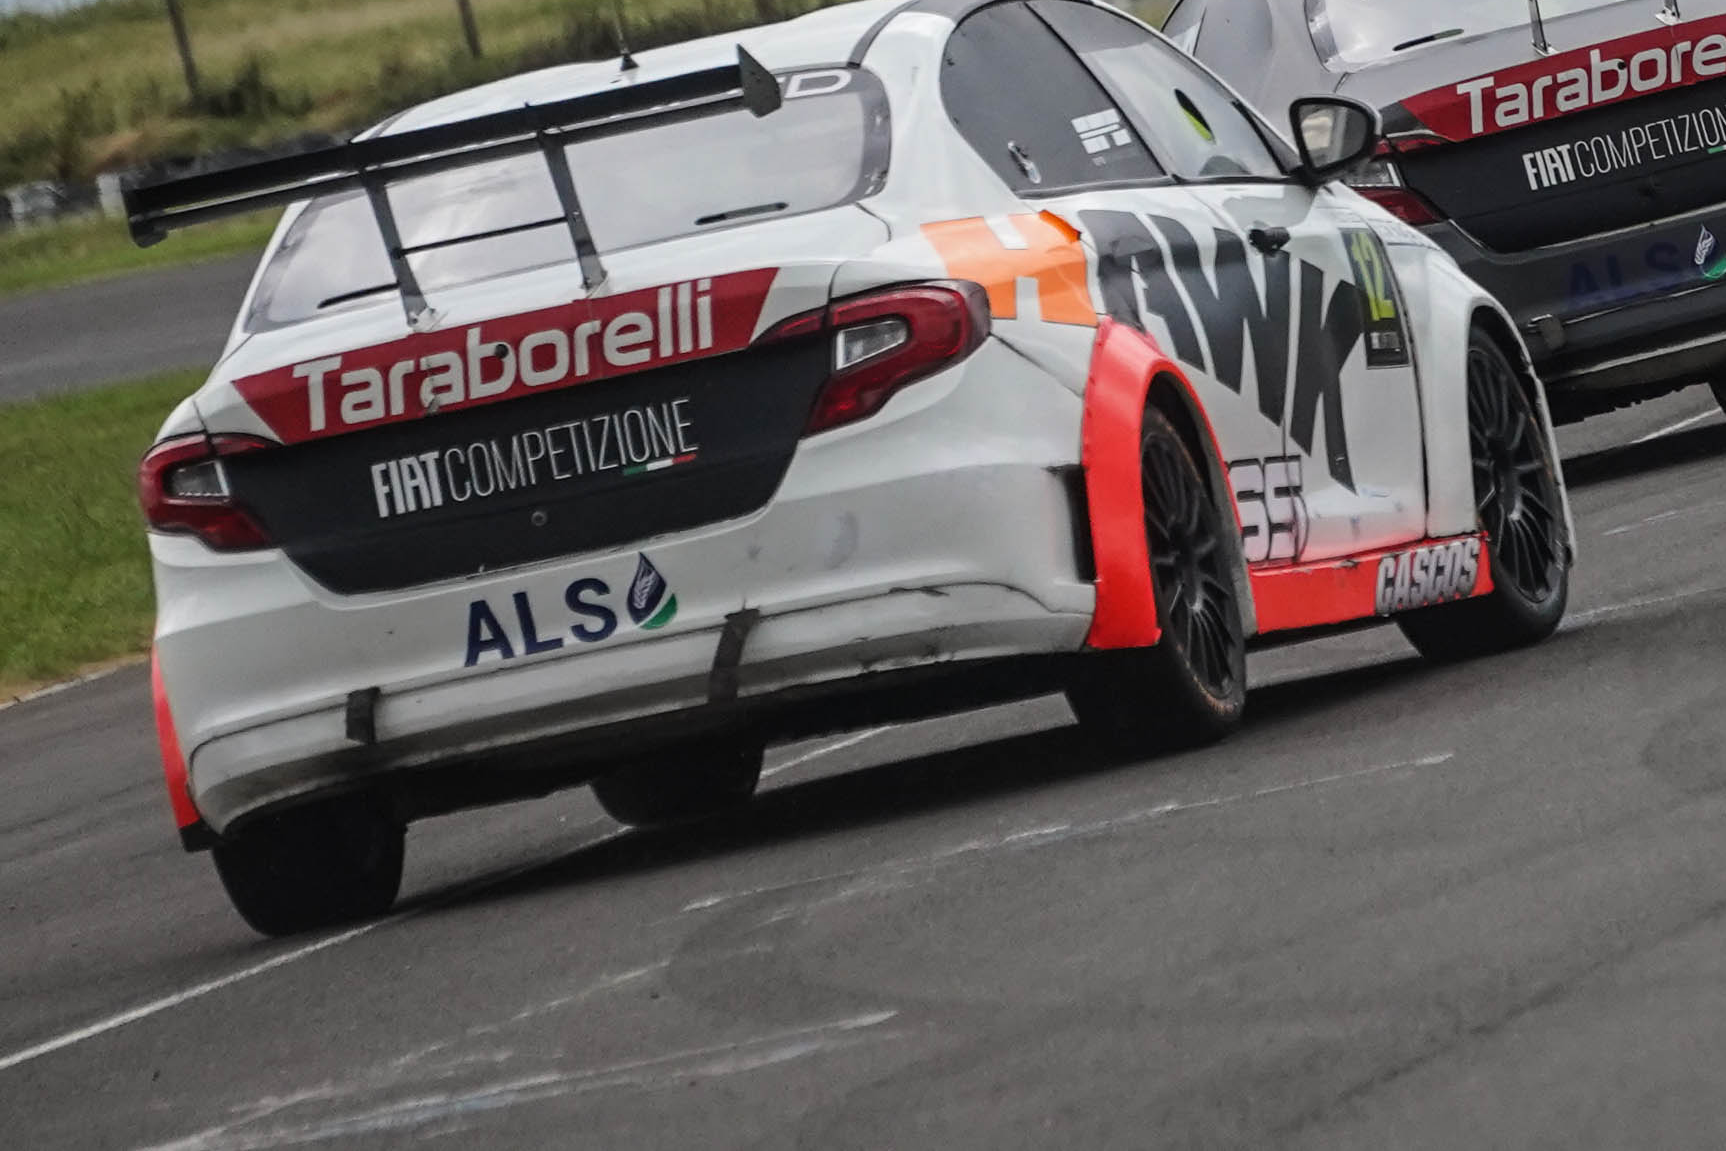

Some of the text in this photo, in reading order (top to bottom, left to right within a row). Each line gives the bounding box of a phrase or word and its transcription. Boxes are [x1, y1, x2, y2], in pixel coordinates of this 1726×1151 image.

[291, 278, 714, 433] Taraborelli
[463, 577, 619, 668] ALS
[1374, 537, 1481, 617] CASCOS
